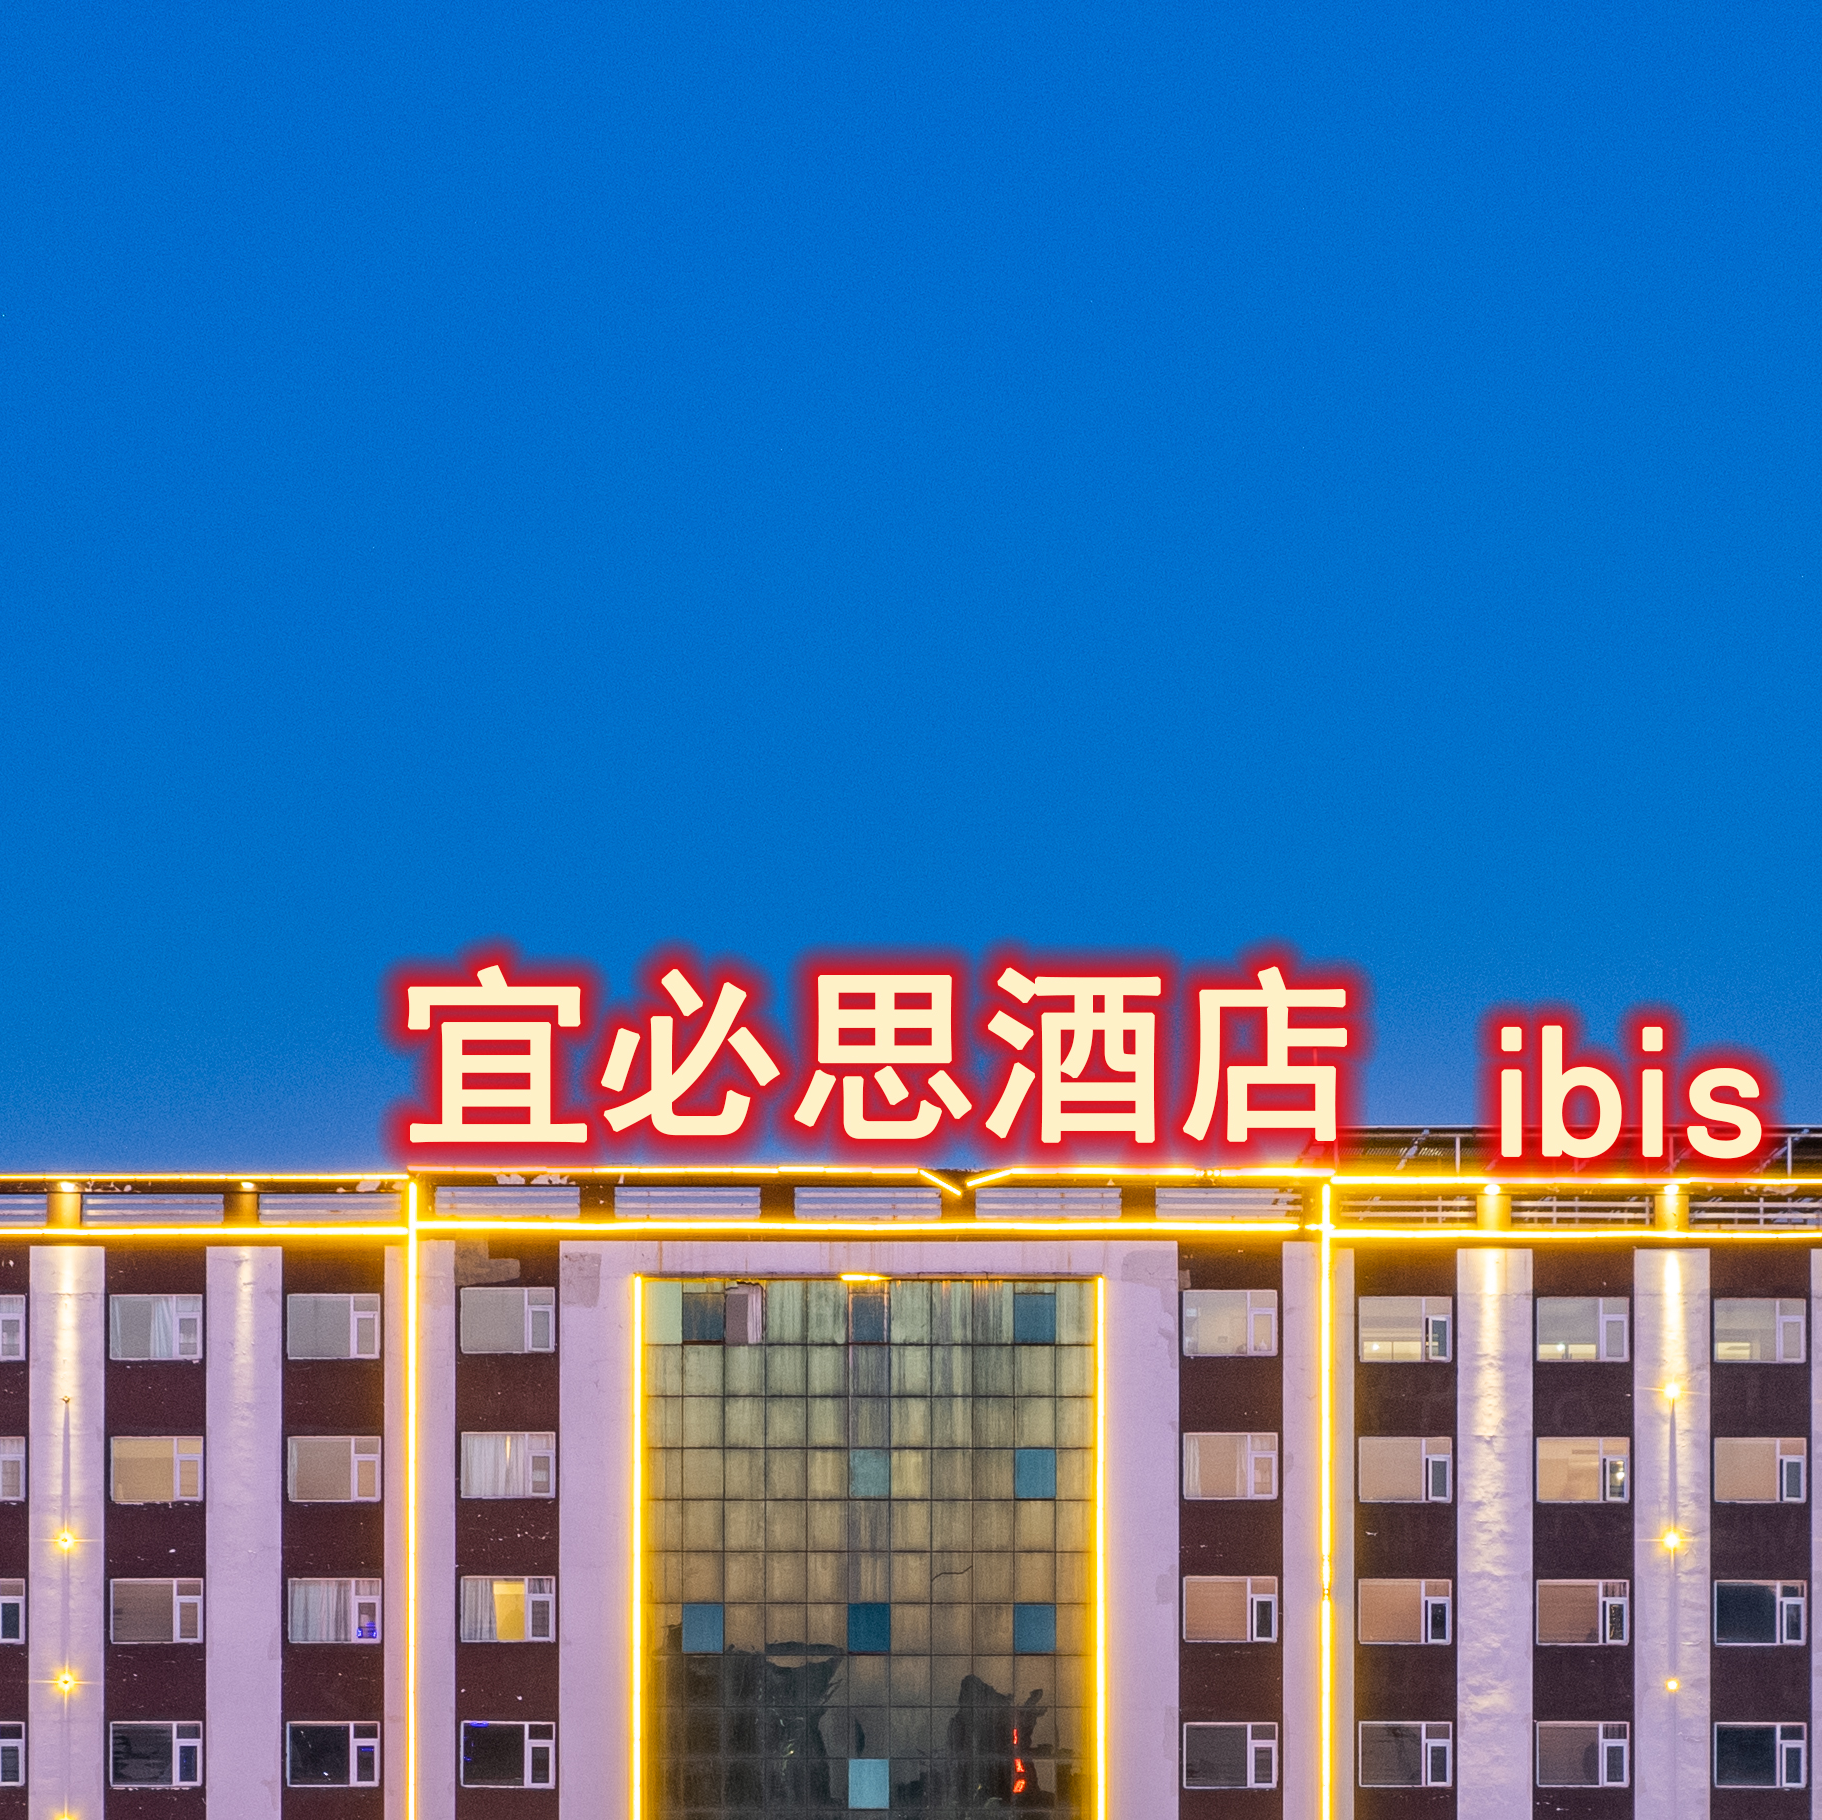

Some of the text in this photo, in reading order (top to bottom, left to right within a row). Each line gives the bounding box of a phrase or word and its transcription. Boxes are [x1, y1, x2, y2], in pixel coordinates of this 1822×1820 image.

[405, 964, 1350, 1146] 宜必思酒店
[1499, 1024, 1764, 1161] ibis
